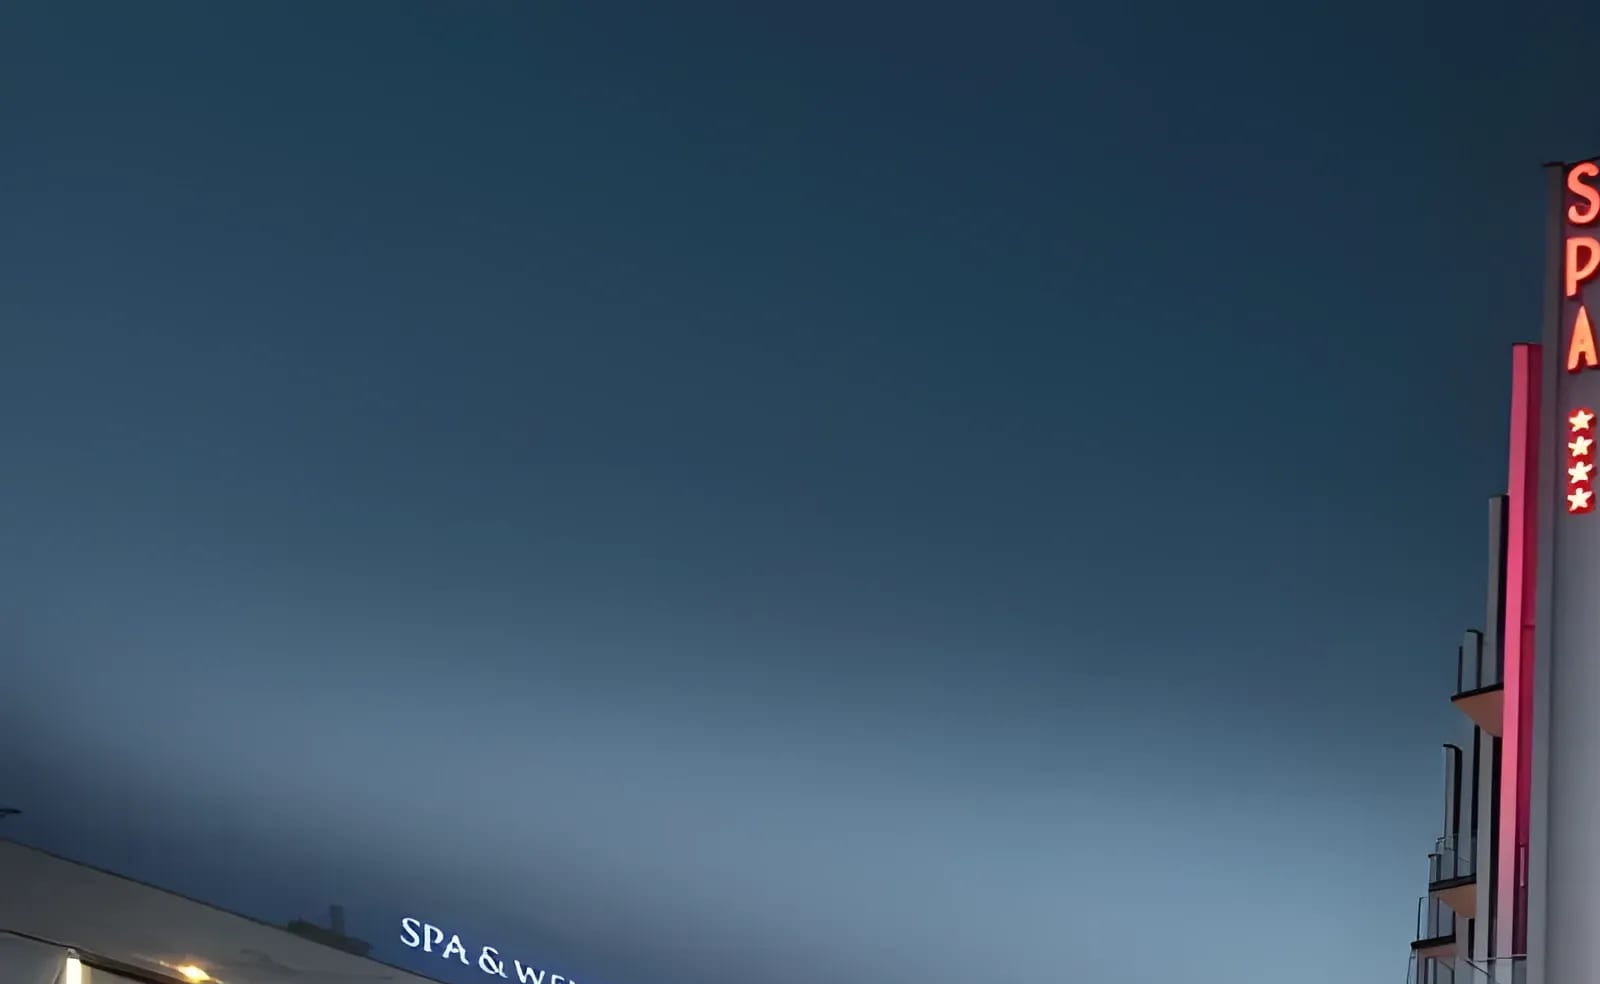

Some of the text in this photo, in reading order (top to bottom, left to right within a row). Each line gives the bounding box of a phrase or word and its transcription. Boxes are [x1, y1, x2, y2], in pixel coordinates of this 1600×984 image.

[1565, 162, 1600, 374] SPA
[400, 917, 470, 965] SPA
[478, 946, 508, 979] &
